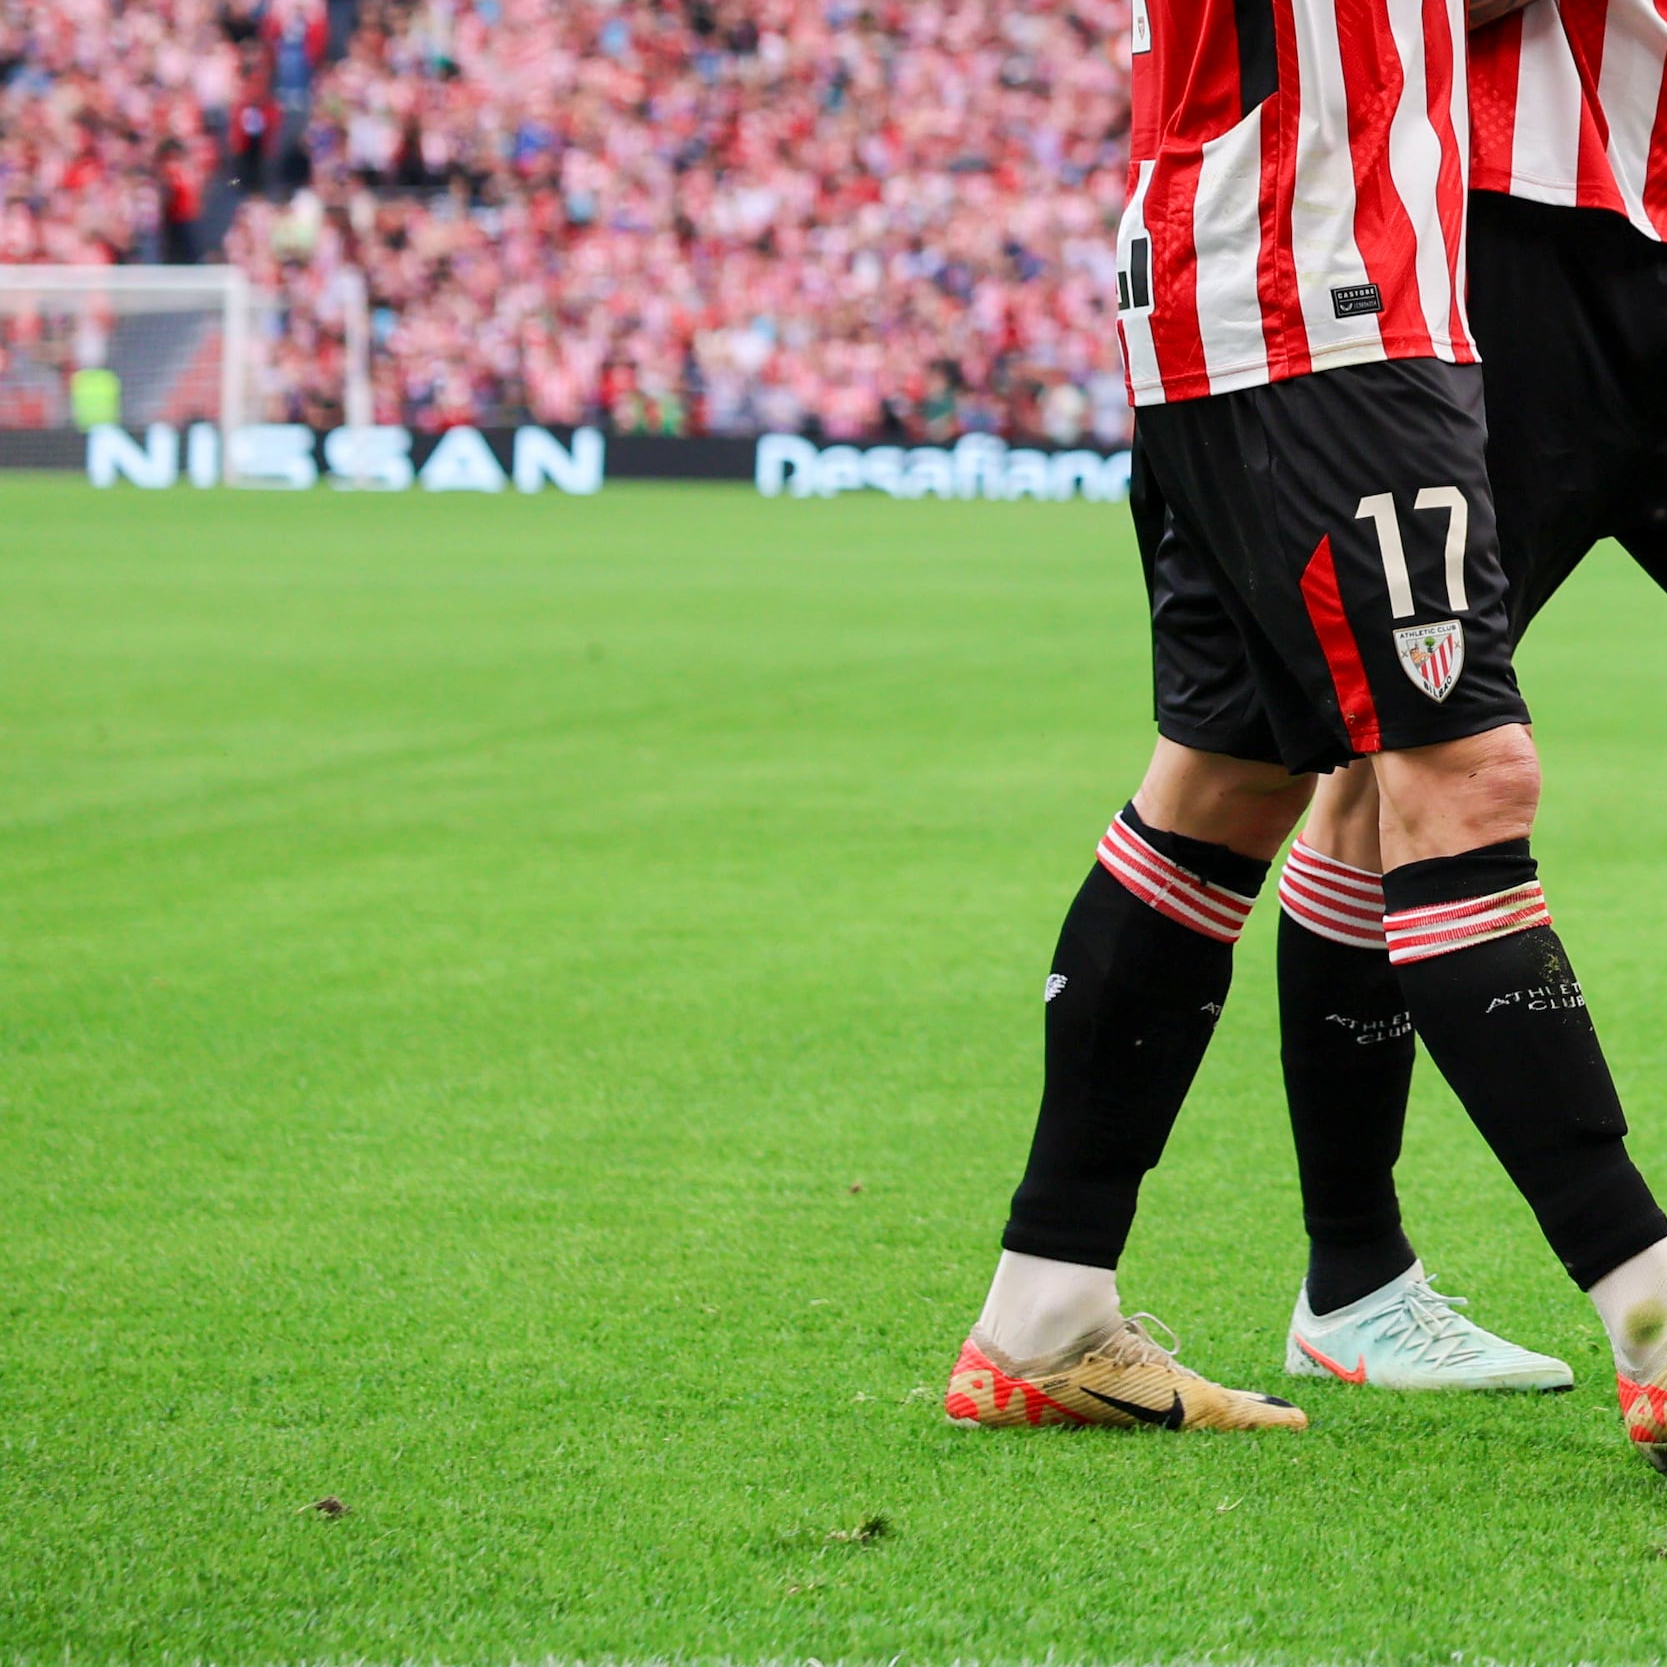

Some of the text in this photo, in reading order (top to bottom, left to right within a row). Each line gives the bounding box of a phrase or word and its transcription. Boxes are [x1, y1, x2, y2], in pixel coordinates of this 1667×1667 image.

[1337, 287, 1375, 300] CASTORE
[87, 422, 603, 495] NISSAN
[1355, 486, 1469, 619] 17
[1400, 624, 1457, 639] ATHLETIC CLUB
[1423, 675, 1453, 699] BILBAO
